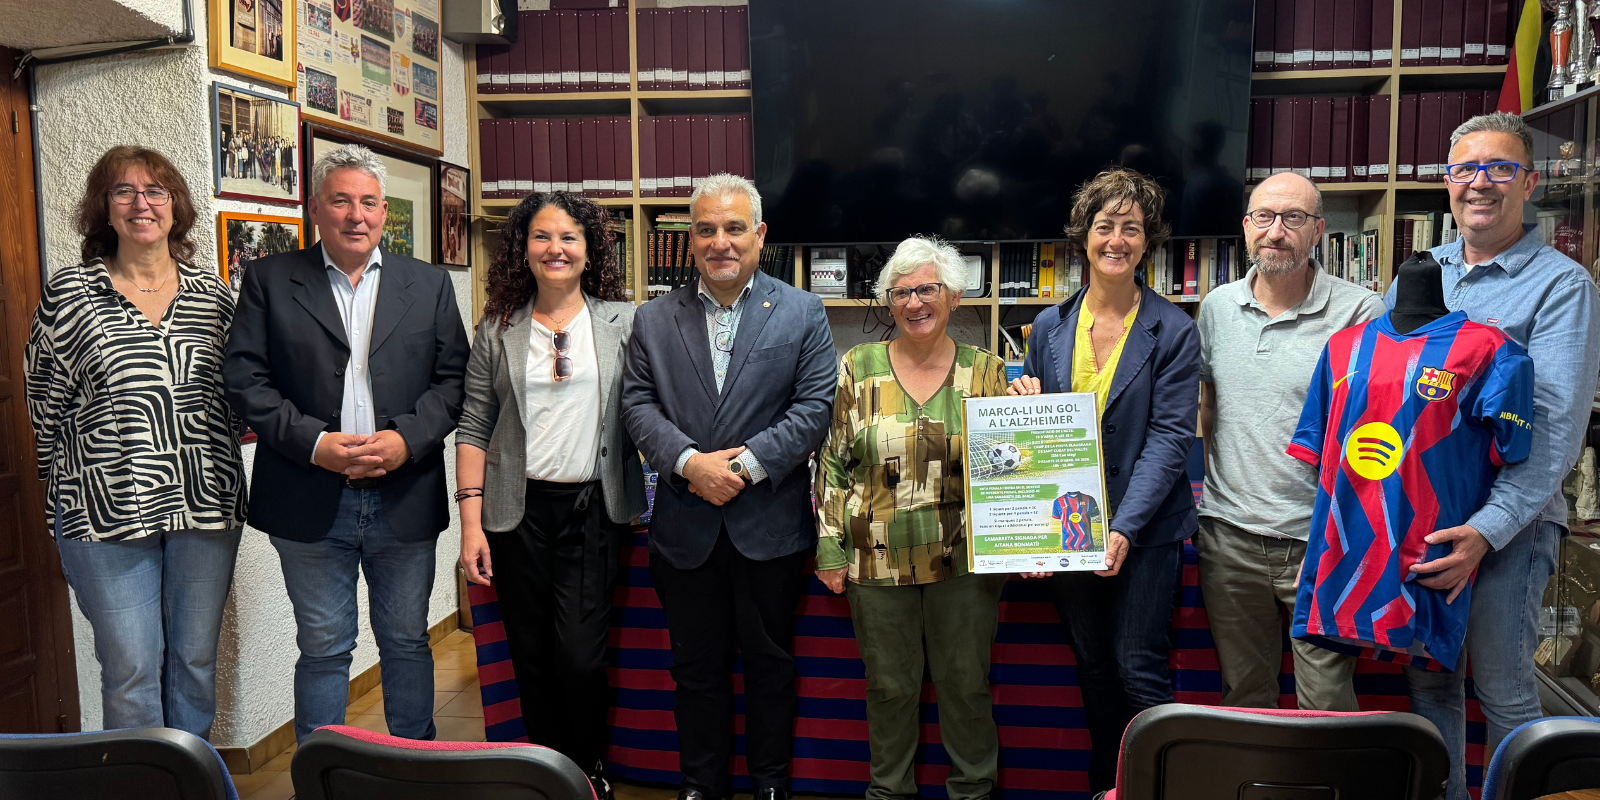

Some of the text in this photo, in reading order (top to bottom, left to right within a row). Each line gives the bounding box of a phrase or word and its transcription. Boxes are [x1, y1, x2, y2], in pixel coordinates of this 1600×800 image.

[978, 404, 1080, 417] MARCA-LI UN GOL
[989, 415, 1073, 428] A L'ALZHEIMER
